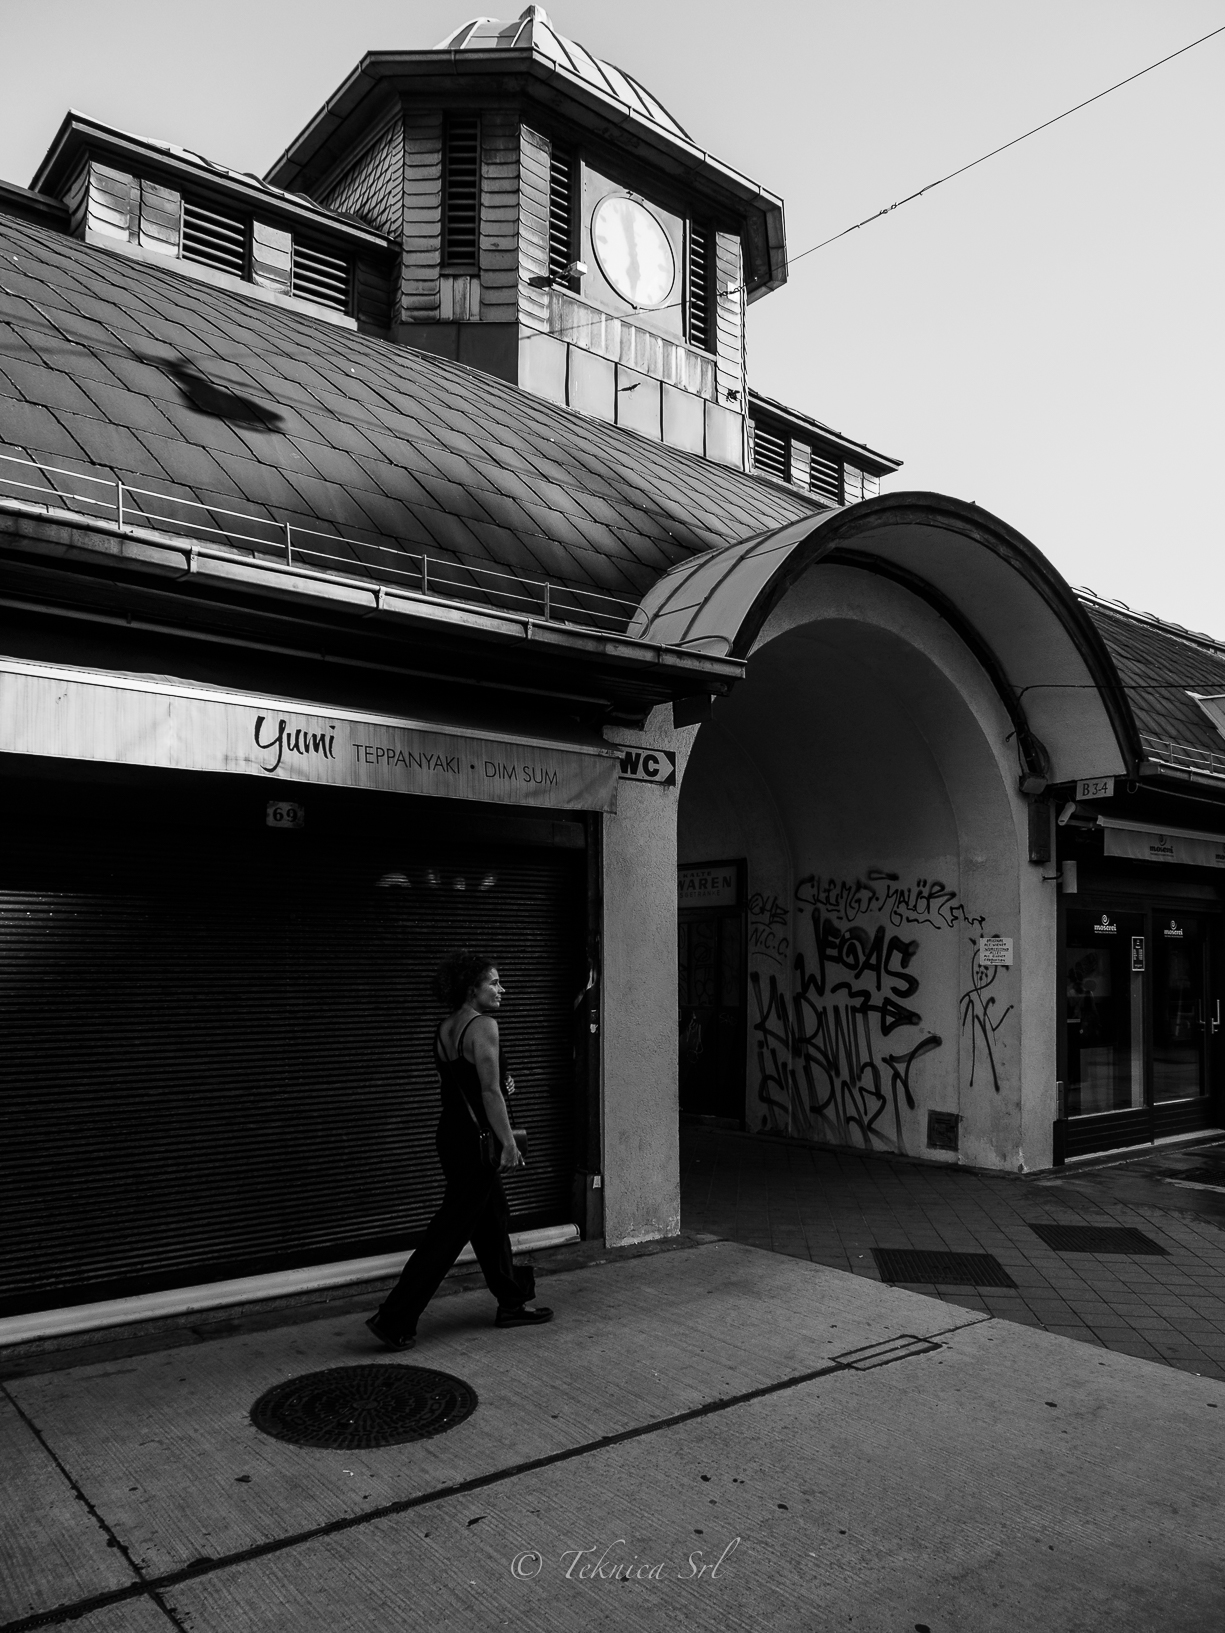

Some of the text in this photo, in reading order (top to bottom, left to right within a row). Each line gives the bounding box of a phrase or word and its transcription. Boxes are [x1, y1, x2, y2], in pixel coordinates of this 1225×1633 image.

[254, 715, 558, 786] Yumi TEPPANYAKI DIM SUM
[619, 751, 660, 778] WC
[273, 807, 297, 823] 69
[682, 870, 712, 879] KALTE
